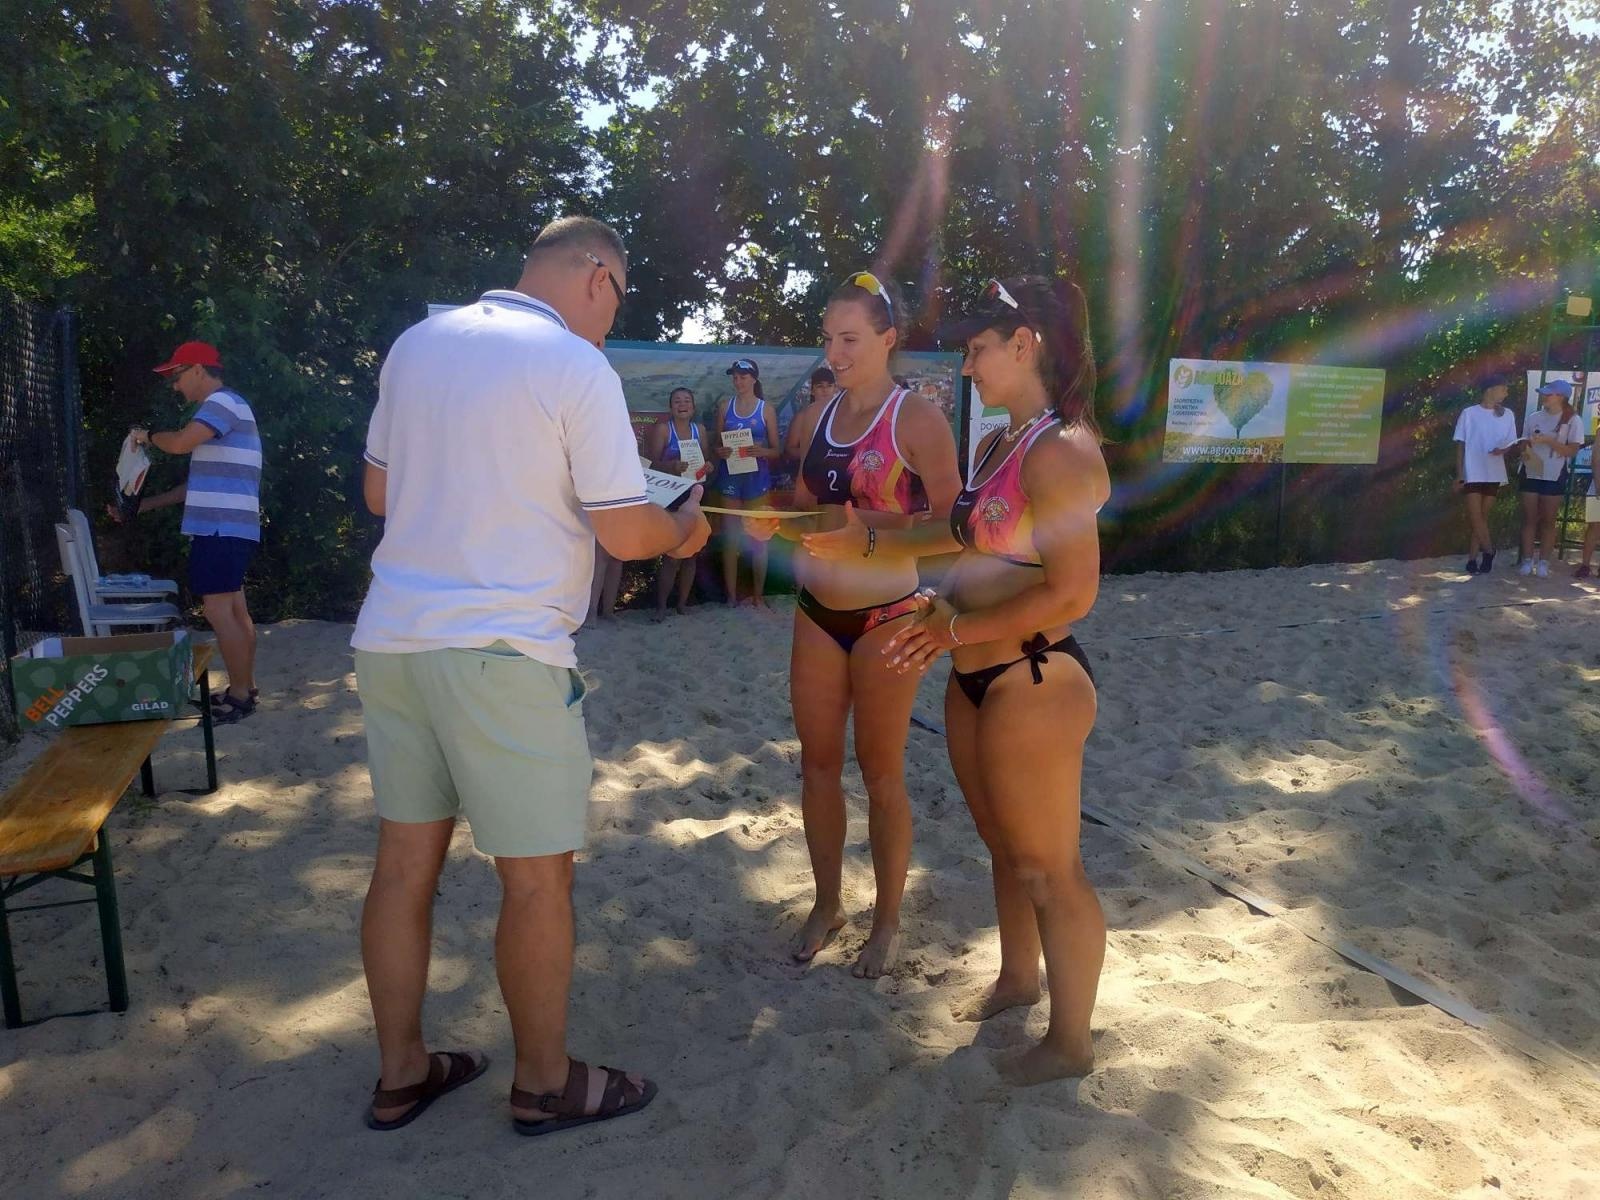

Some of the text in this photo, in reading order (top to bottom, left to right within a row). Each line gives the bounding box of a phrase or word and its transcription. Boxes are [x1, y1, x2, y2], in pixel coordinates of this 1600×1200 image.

[1588, 388, 1600, 401] ZA
[724, 431, 750, 440] DYPLOM
[1182, 444, 1263, 457] www.agrooaza.pl
[827, 470, 839, 491] 2
[45, 664, 109, 727] PEPPERS
[24, 687, 65, 723] BELL
[131, 701, 169, 712] GILAD
